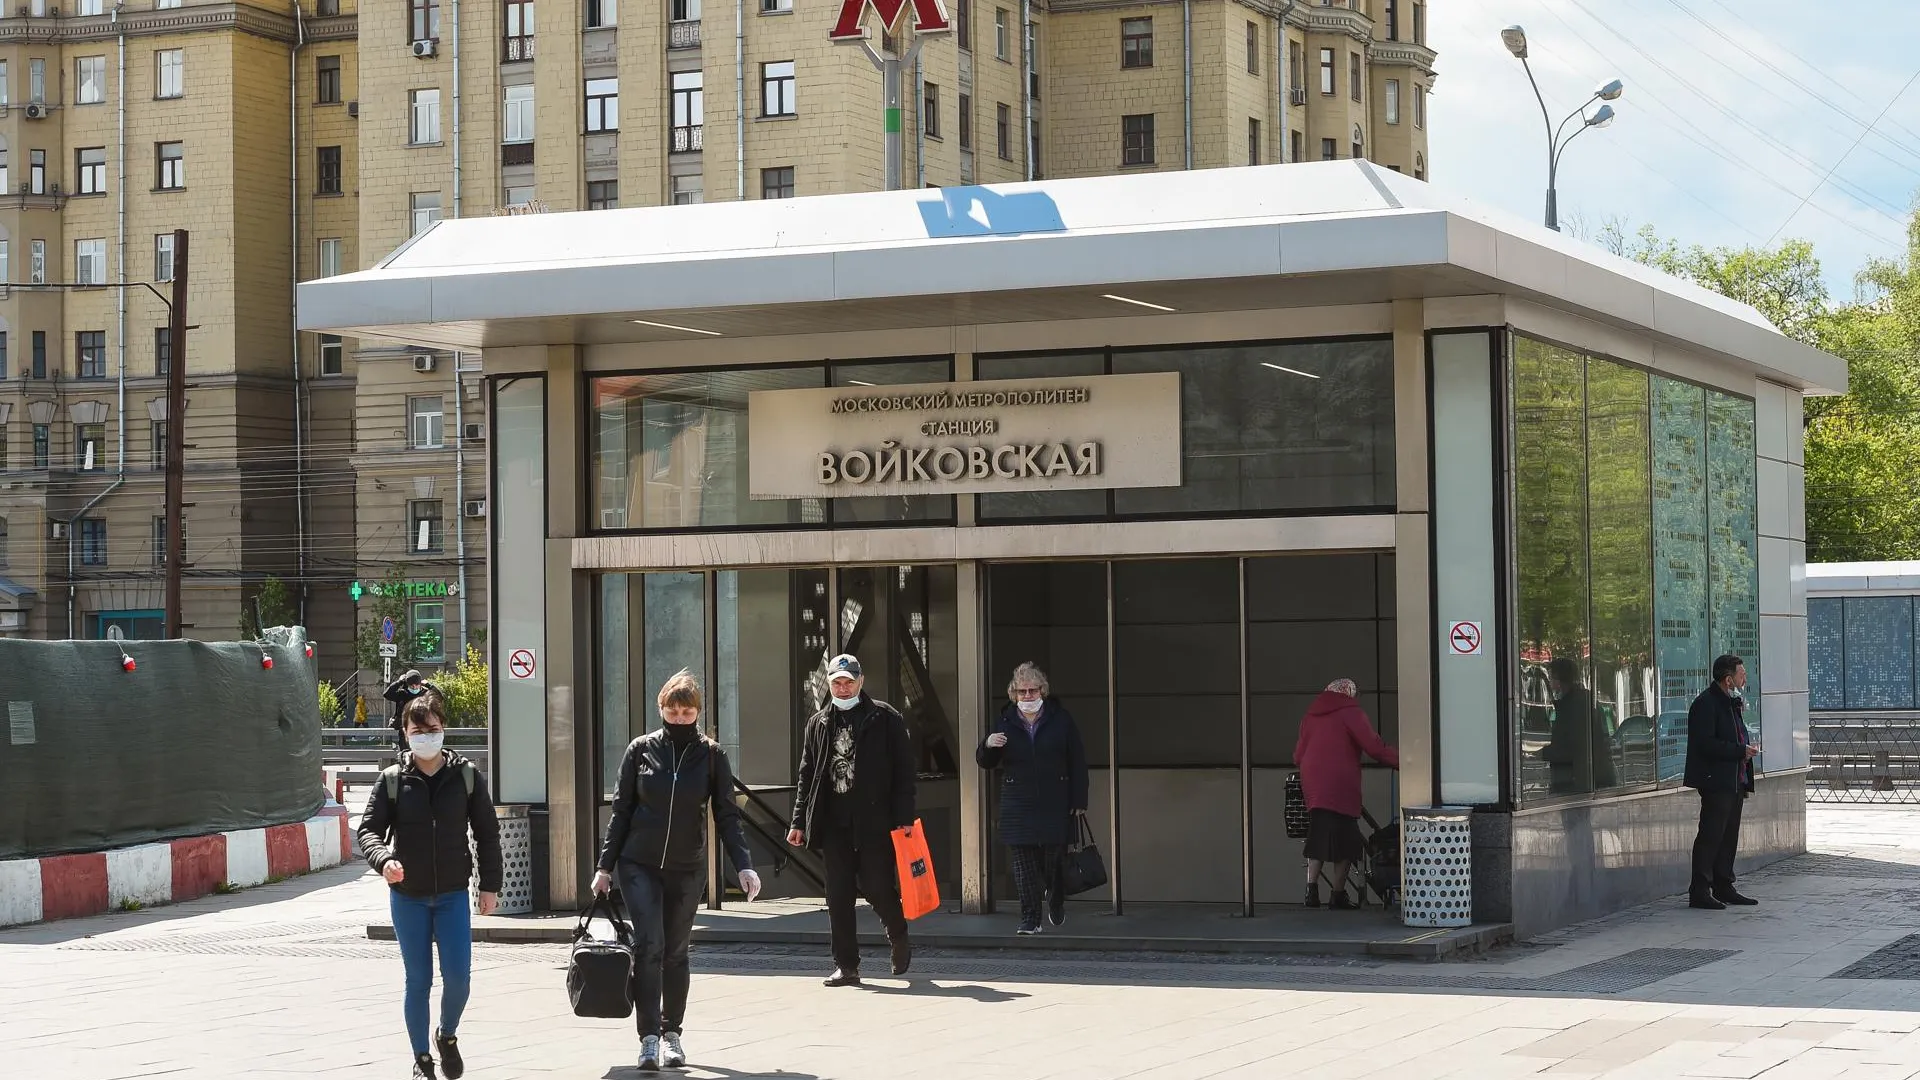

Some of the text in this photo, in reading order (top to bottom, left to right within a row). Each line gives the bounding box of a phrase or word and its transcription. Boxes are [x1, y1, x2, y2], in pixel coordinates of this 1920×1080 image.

[832, 388, 1087, 413] МОСКОВСКИЙ МЕТРОПОЛИТЕН
[920, 419, 995, 437] СТАНЦИЯ
[818, 440, 1101, 484] ВОЙКОВСКАЯ
